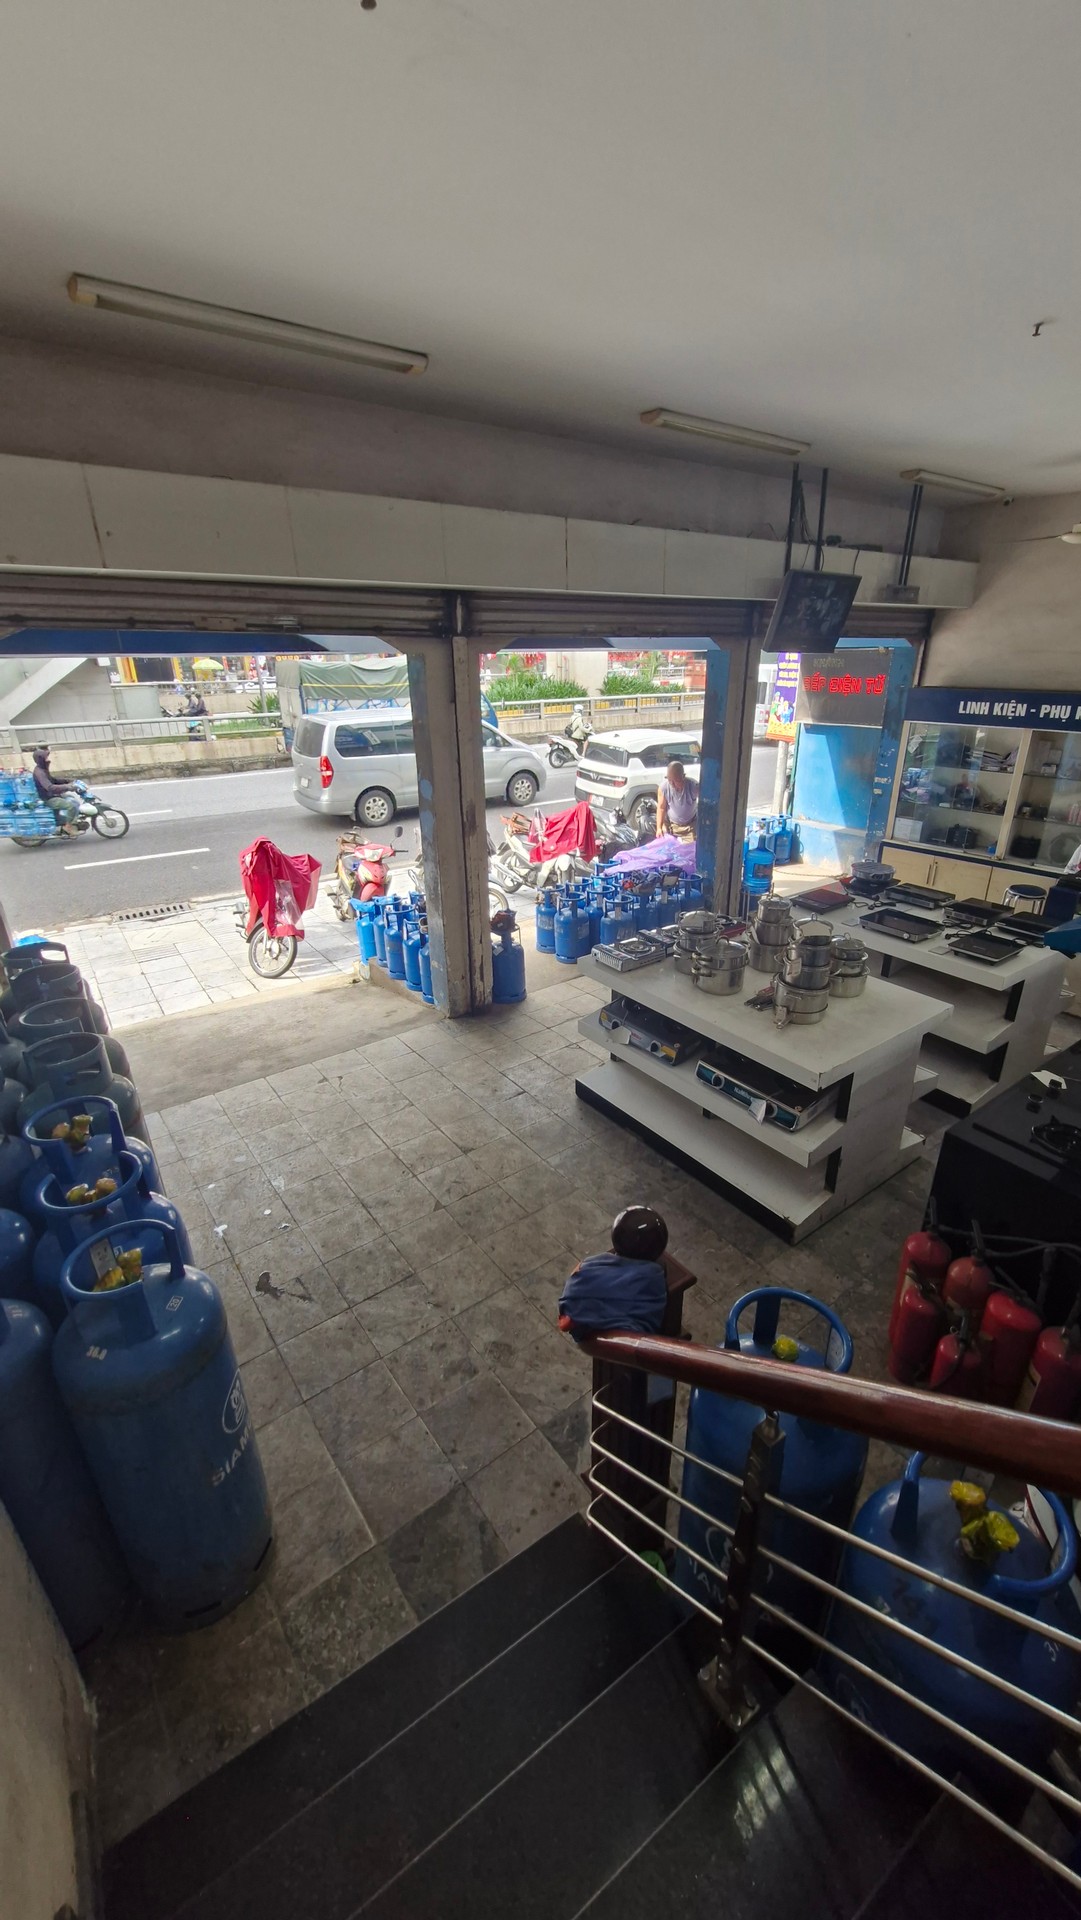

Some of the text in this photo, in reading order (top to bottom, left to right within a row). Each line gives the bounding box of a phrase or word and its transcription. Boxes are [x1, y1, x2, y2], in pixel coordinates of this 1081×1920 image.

[958, 701, 990, 715] LINH
[993, 700, 1027, 719] KIỆN
[1039, 704, 1072, 722] PHỤ
